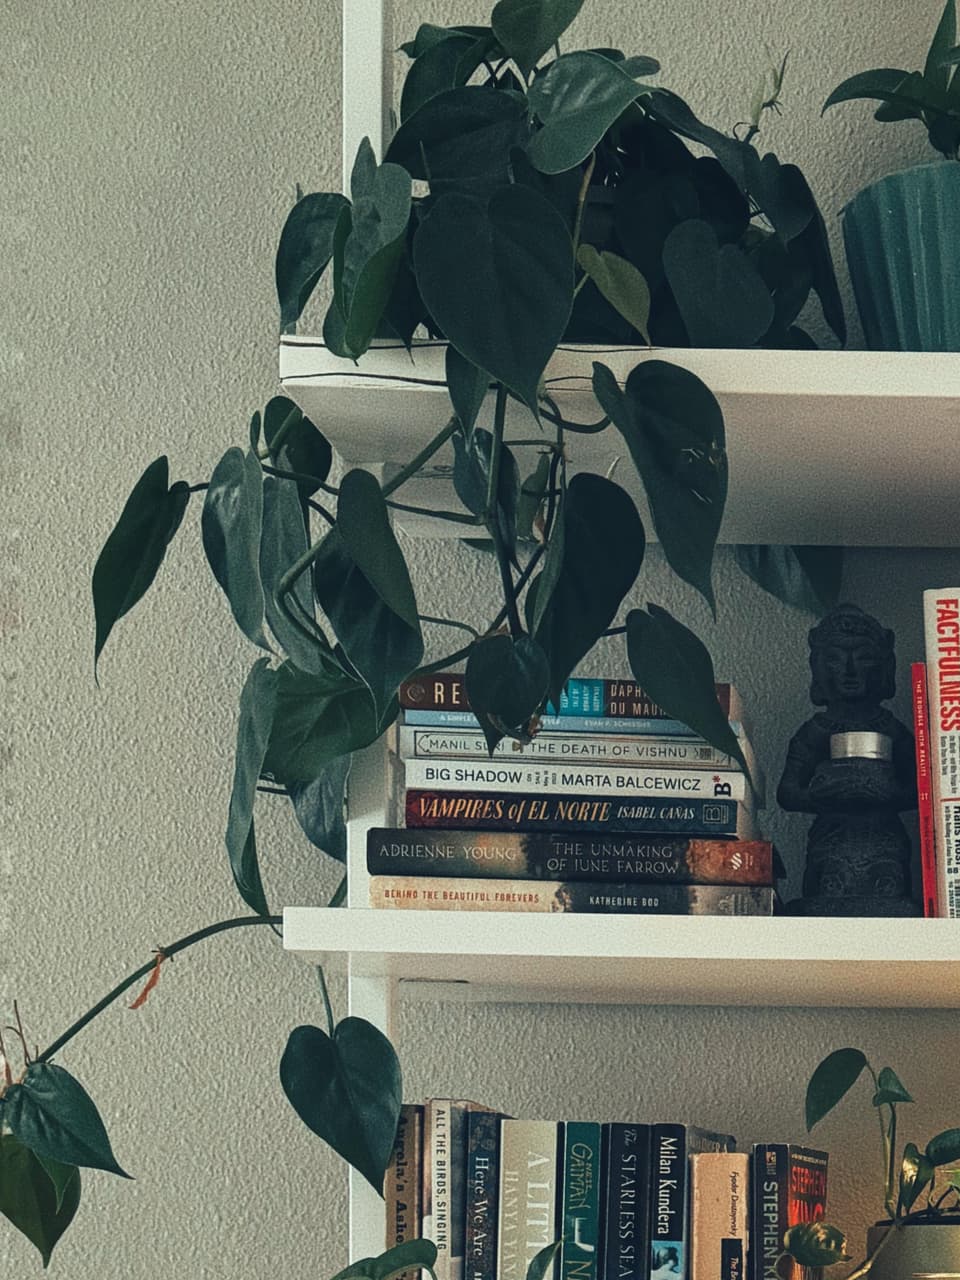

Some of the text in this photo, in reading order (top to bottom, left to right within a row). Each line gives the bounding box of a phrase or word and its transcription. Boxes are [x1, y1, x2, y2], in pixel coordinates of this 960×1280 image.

[530, 742, 687, 759] THE DEATH OF VISHNU
[425, 767, 449, 781] BIG
[455, 768, 522, 784] SHADOW
[562, 773, 613, 787] MARTA
[616, 775, 701, 792] BALCEWICZ
[418, 798, 612, 824] VAMPIRES of EL NORTE
[379, 844, 516, 862] ADRIENNE YOUNG
[553, 842, 673, 859] THE UNMAKING
[435, 1109, 447, 1251] ALL THE BIRDS, SINGING
[568, 1142, 594, 1210] GAIMAN
[657, 1135, 679, 1235] Milan Kundera
[472, 1156, 489, 1257] Here We Are
[618, 1128, 637, 1278] The STARLESS SEA
[763, 1181, 779, 1260] STEPHEN
